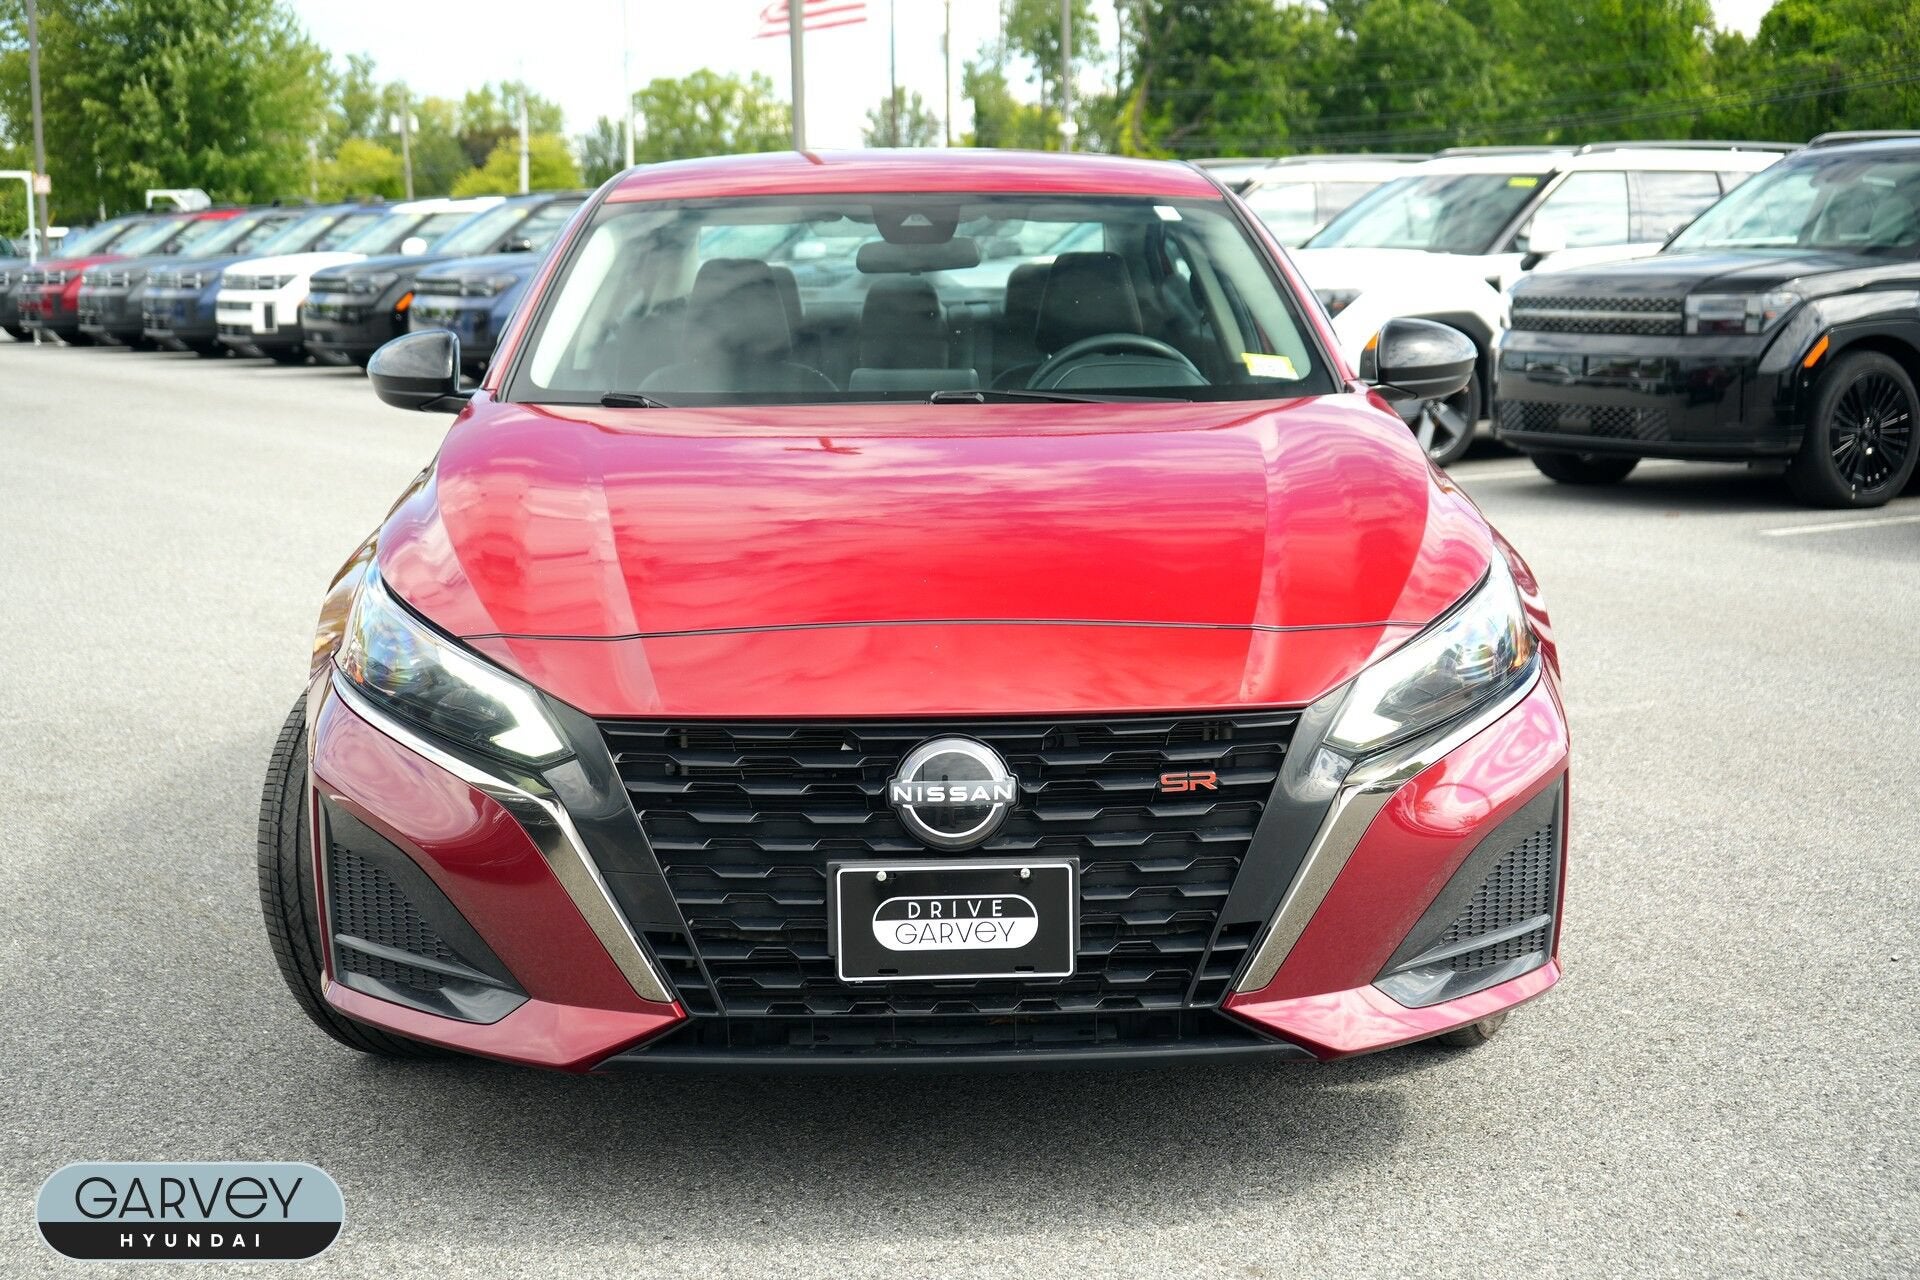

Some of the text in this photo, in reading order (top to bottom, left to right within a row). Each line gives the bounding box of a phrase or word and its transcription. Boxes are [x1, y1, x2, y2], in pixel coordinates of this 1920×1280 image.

[1160, 770, 1218, 793] SR
[893, 783, 1013, 802] NISSAN
[907, 899, 1003, 919] DRIVE
